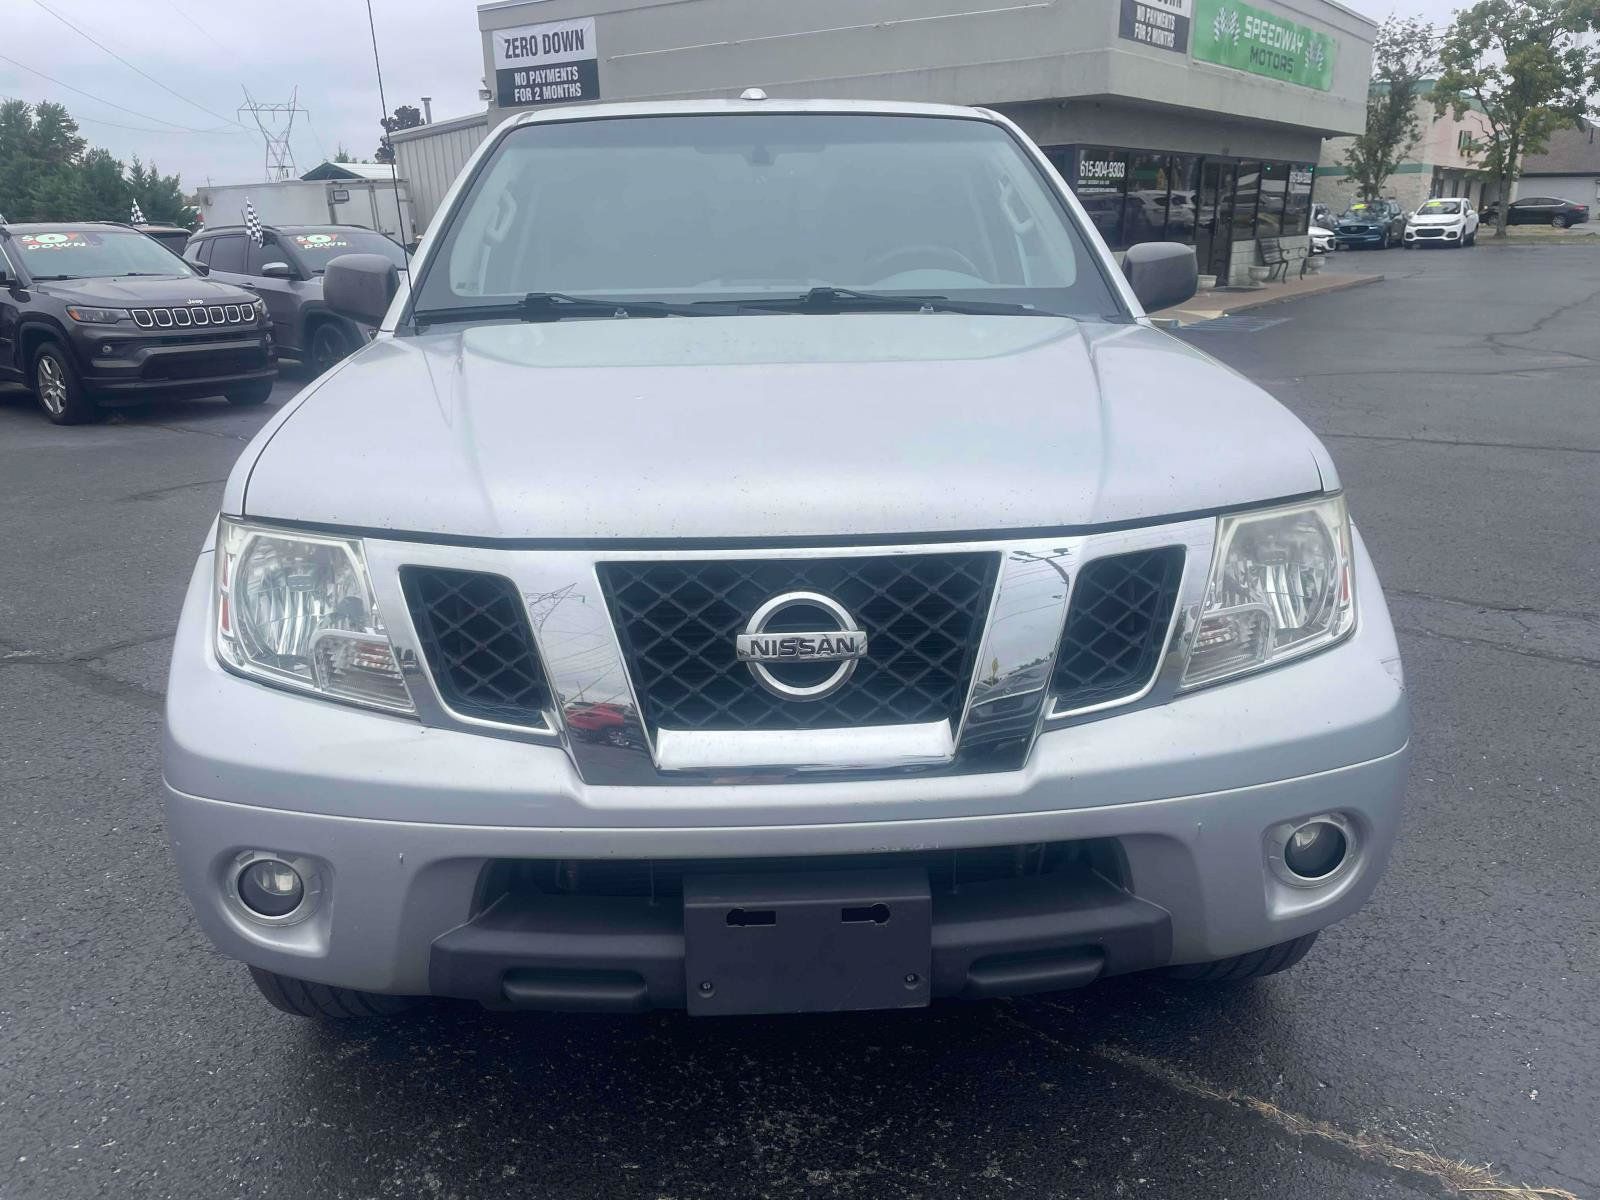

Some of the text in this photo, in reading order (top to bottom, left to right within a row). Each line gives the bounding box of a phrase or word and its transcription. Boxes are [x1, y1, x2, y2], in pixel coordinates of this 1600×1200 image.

[504, 29, 585, 59] ZERO DOWN
[1244, 15, 1305, 54] SPEEDWAY
[1249, 45, 1295, 74] MOTORS
[514, 66, 579, 86] NO PAYMENTS
[514, 82, 582, 102] FOR 2 MONTHS
[28, 242, 86, 250] DOWN
[750, 637, 855, 657] NISSAN
